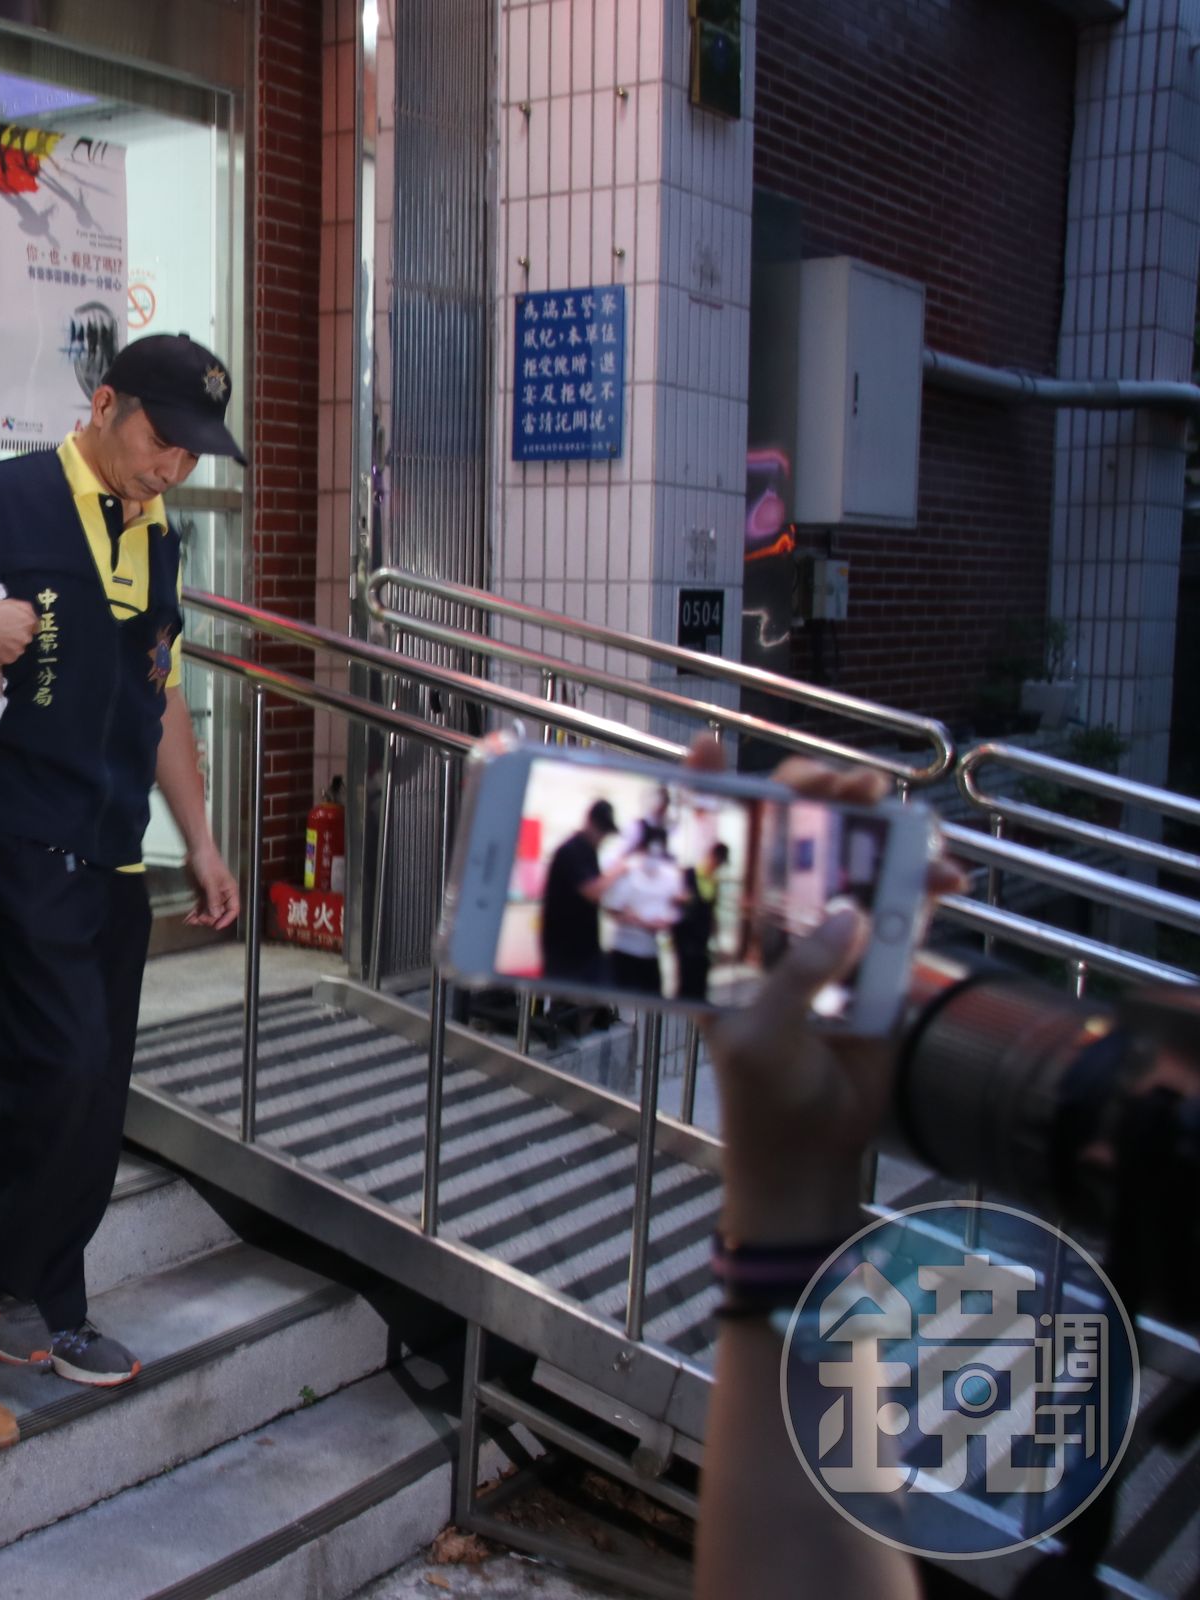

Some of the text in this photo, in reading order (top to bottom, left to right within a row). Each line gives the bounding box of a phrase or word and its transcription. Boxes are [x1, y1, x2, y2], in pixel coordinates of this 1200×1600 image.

[682, 601, 721, 626] 0504
[33, 587, 59, 707] 中正第一分局
[287, 897, 344, 935] 滅火
